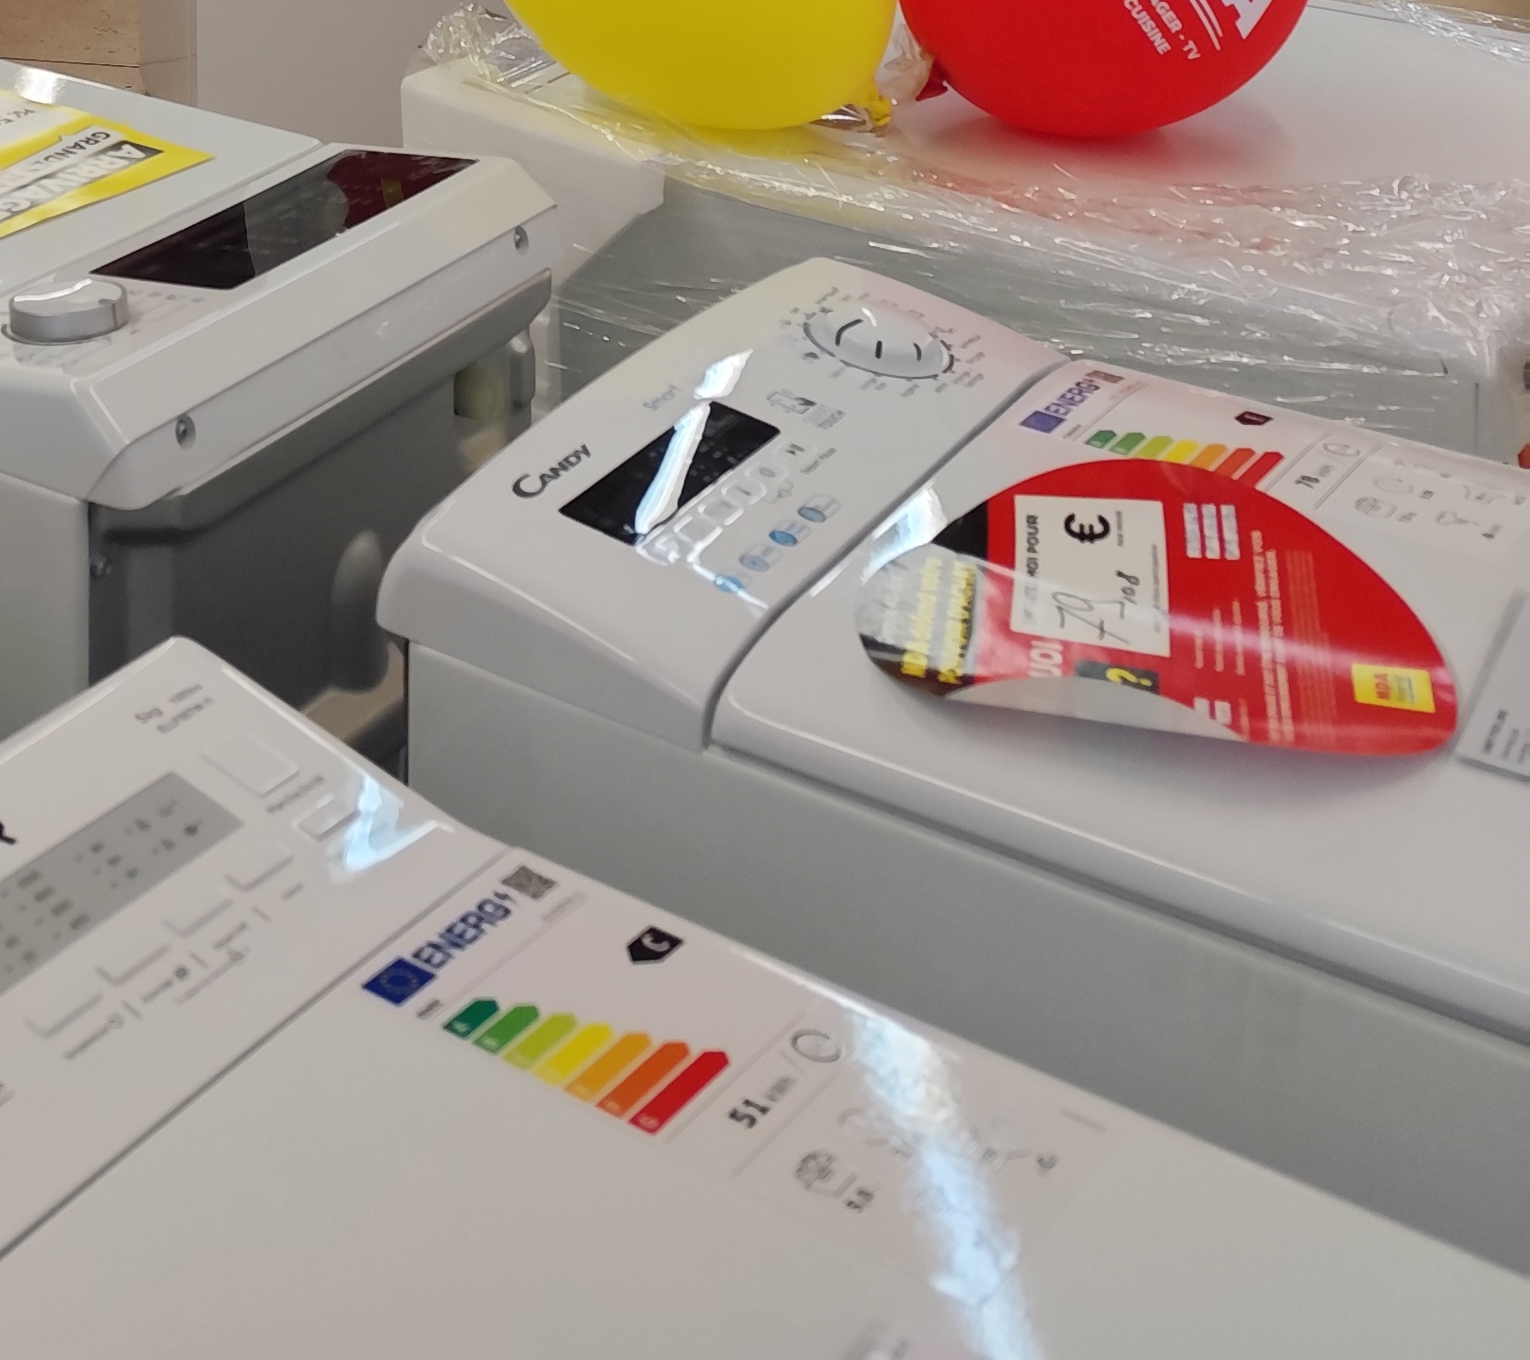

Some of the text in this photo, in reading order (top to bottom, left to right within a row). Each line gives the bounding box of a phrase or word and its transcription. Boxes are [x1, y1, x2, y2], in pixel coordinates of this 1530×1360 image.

[1182, 40, 1201, 60] TV
[1043, 377, 1100, 418] ENERG
[511, 442, 592, 499] CANDY
[1063, 512, 1111, 544] €
[412, 896, 513, 971] ENERG
